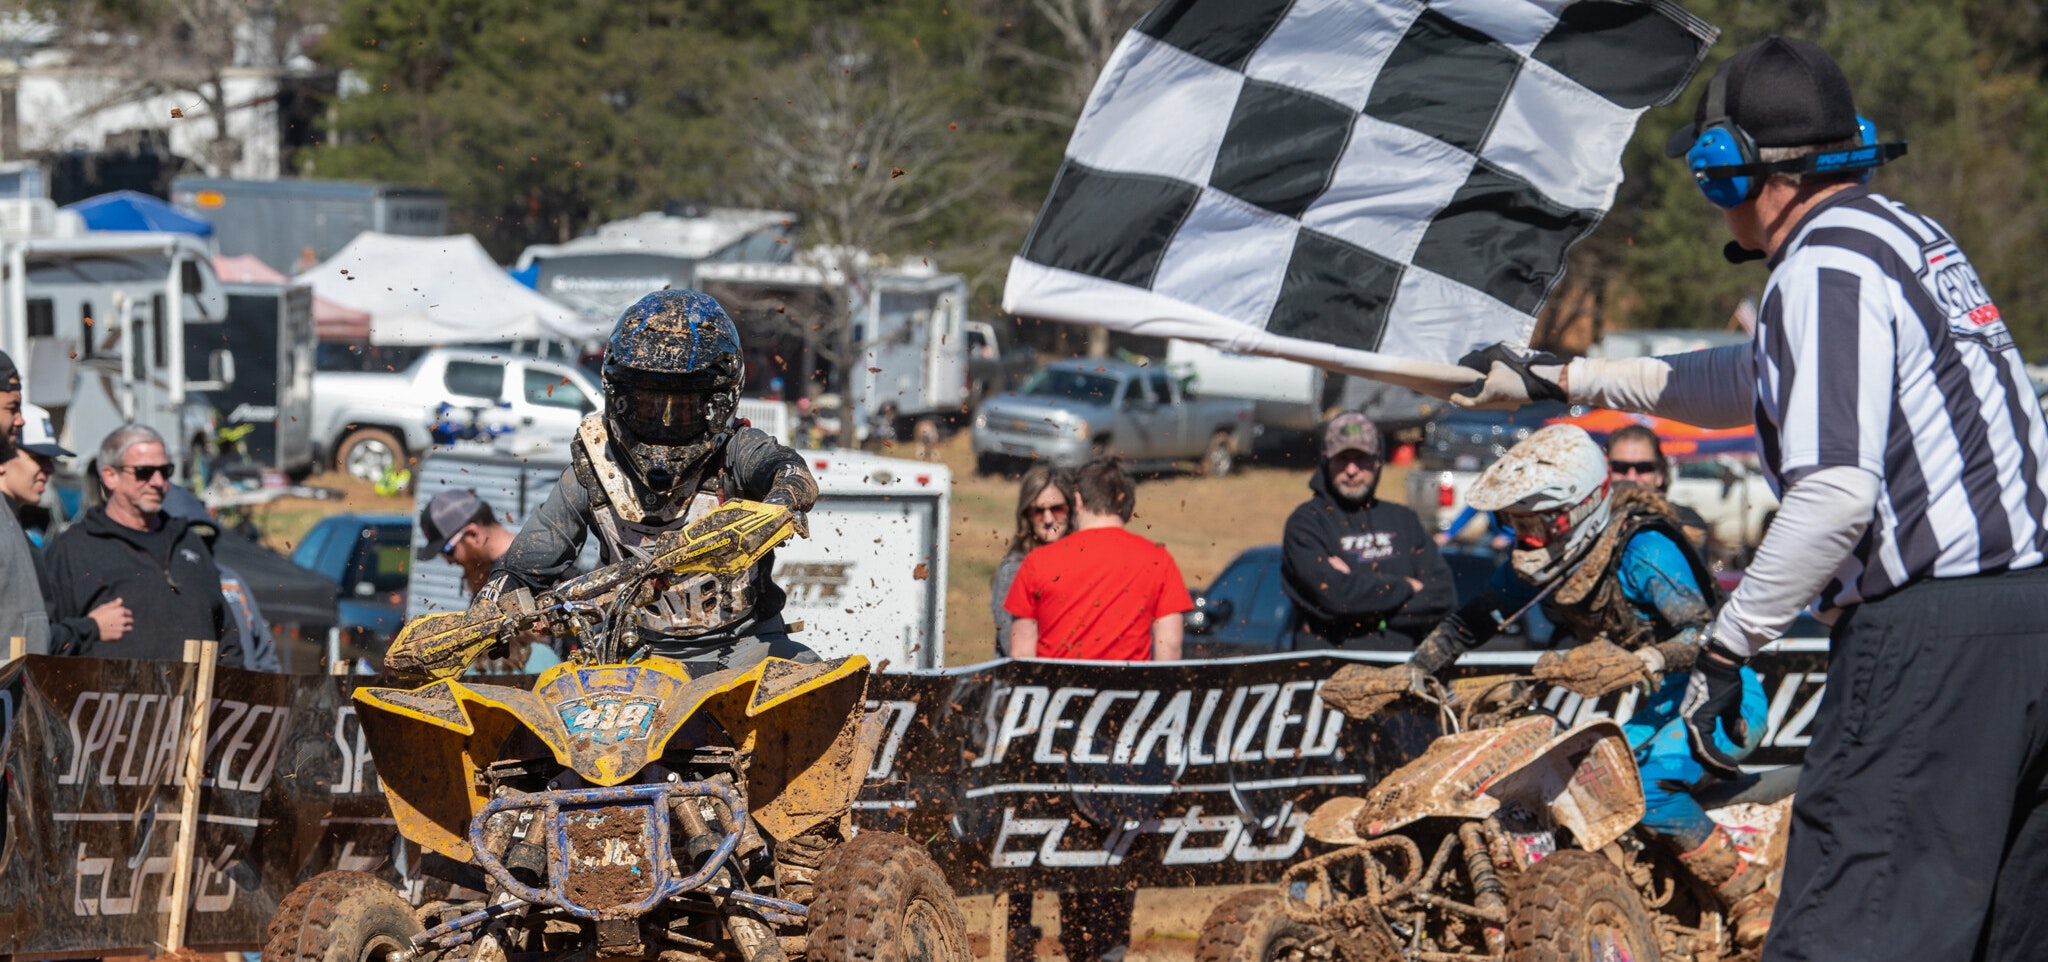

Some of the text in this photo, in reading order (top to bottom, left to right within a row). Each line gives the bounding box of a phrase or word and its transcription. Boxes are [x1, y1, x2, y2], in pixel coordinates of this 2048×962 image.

[58, 691, 290, 793] SPECIALZED
[971, 680, 1345, 768] SPECIALIZED
[990, 801, 1309, 868] turbo
